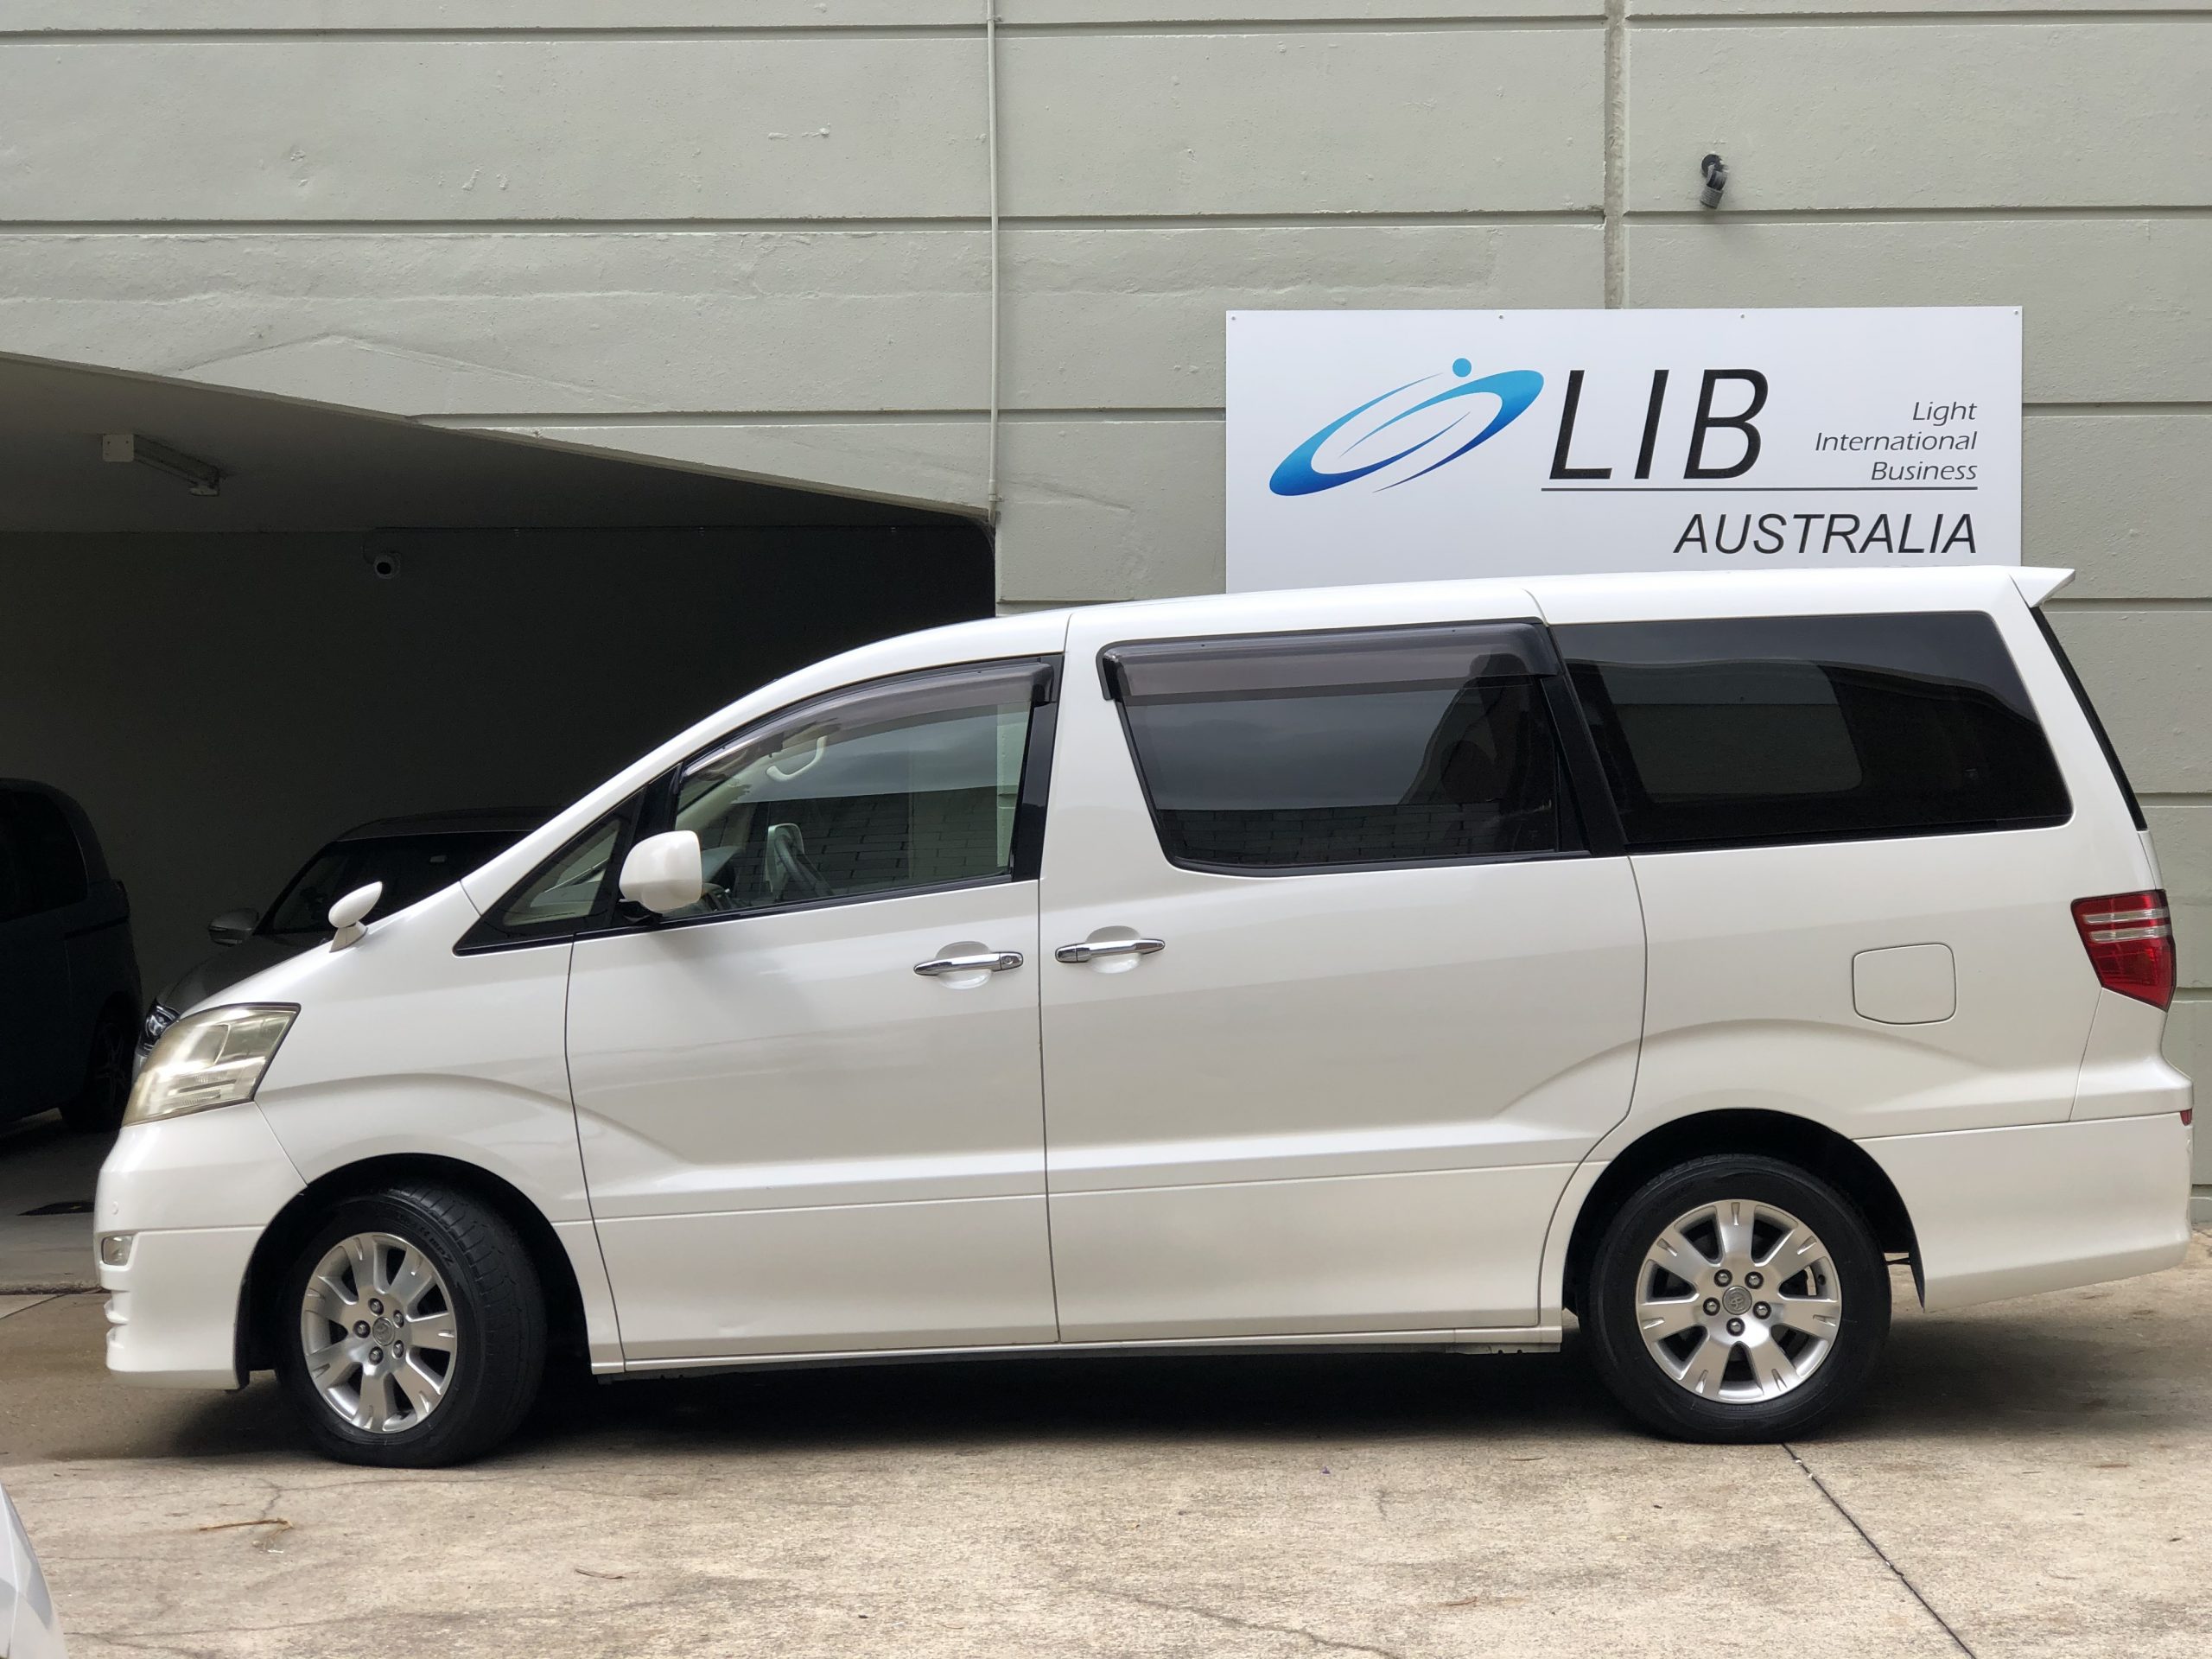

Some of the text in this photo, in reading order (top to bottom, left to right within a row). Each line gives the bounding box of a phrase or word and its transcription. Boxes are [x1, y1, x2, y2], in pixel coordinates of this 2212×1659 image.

[1549, 369, 1769, 480] LIB
[1912, 401, 1978, 427] Light
[1815, 430, 1978, 451] International
[1871, 461, 1978, 480] Business
[1673, 513, 1977, 555] AUSTRALIA
